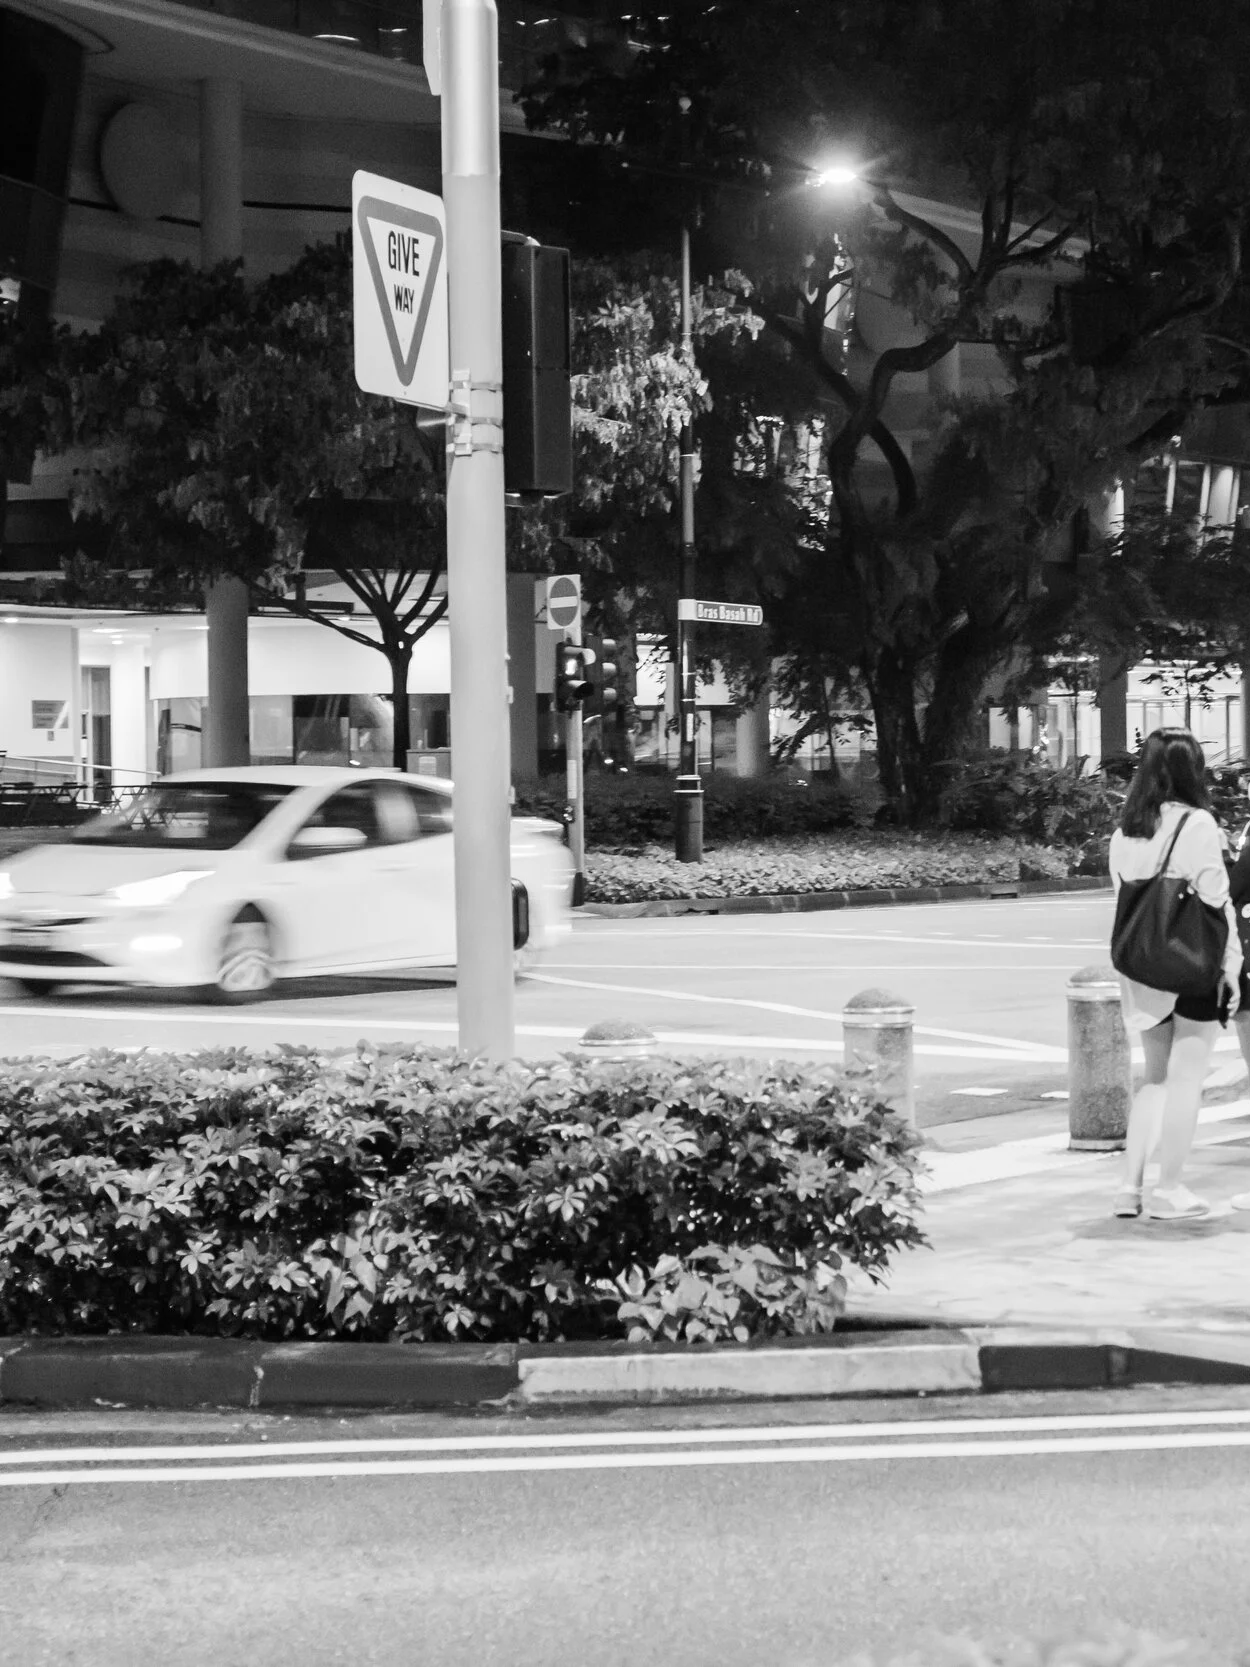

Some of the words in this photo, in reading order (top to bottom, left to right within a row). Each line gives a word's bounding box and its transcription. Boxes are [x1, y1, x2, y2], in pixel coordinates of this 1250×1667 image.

[387, 230, 420, 277] GIVE
[393, 283, 415, 314] WAY
[698, 603, 718, 619] Bras
[719, 605, 746, 621] Basah
